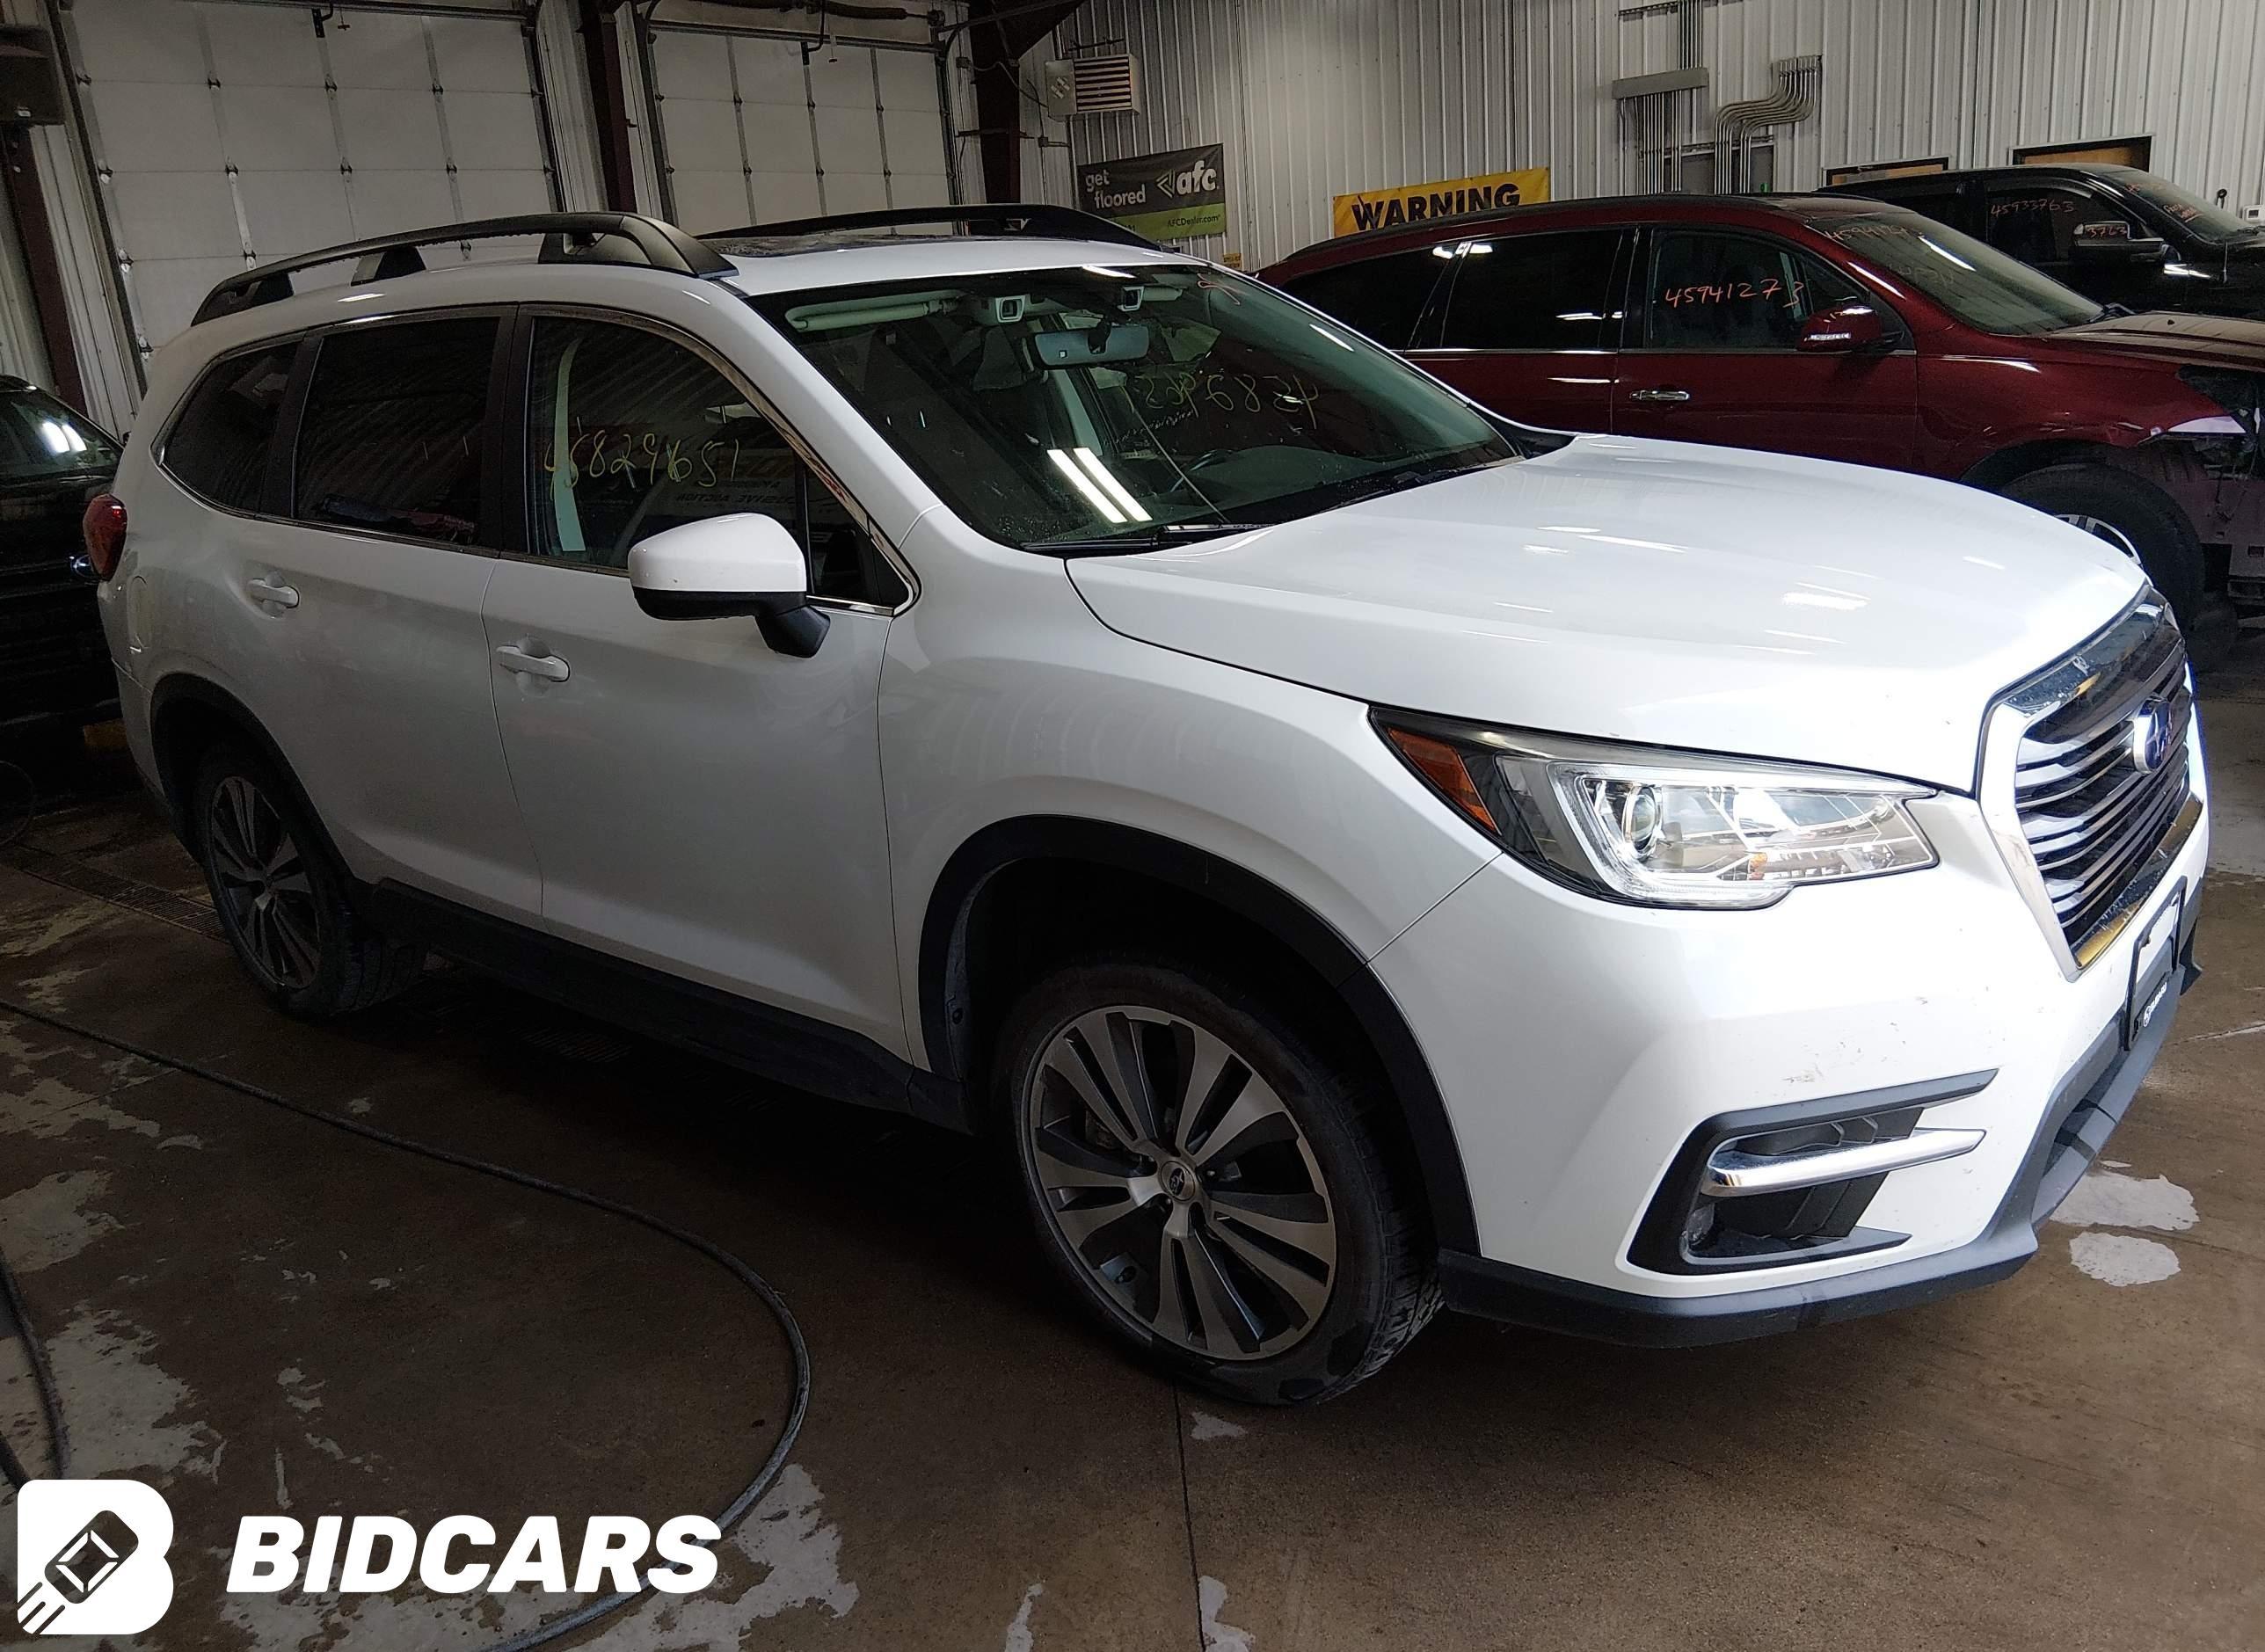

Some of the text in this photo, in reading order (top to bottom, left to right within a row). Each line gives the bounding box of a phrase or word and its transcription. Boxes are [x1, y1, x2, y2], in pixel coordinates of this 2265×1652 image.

[1085, 170, 1111, 193] get
[1176, 160, 1217, 196] afc
[1094, 184, 1147, 210] floored
[1351, 183, 1520, 231] WARNING
